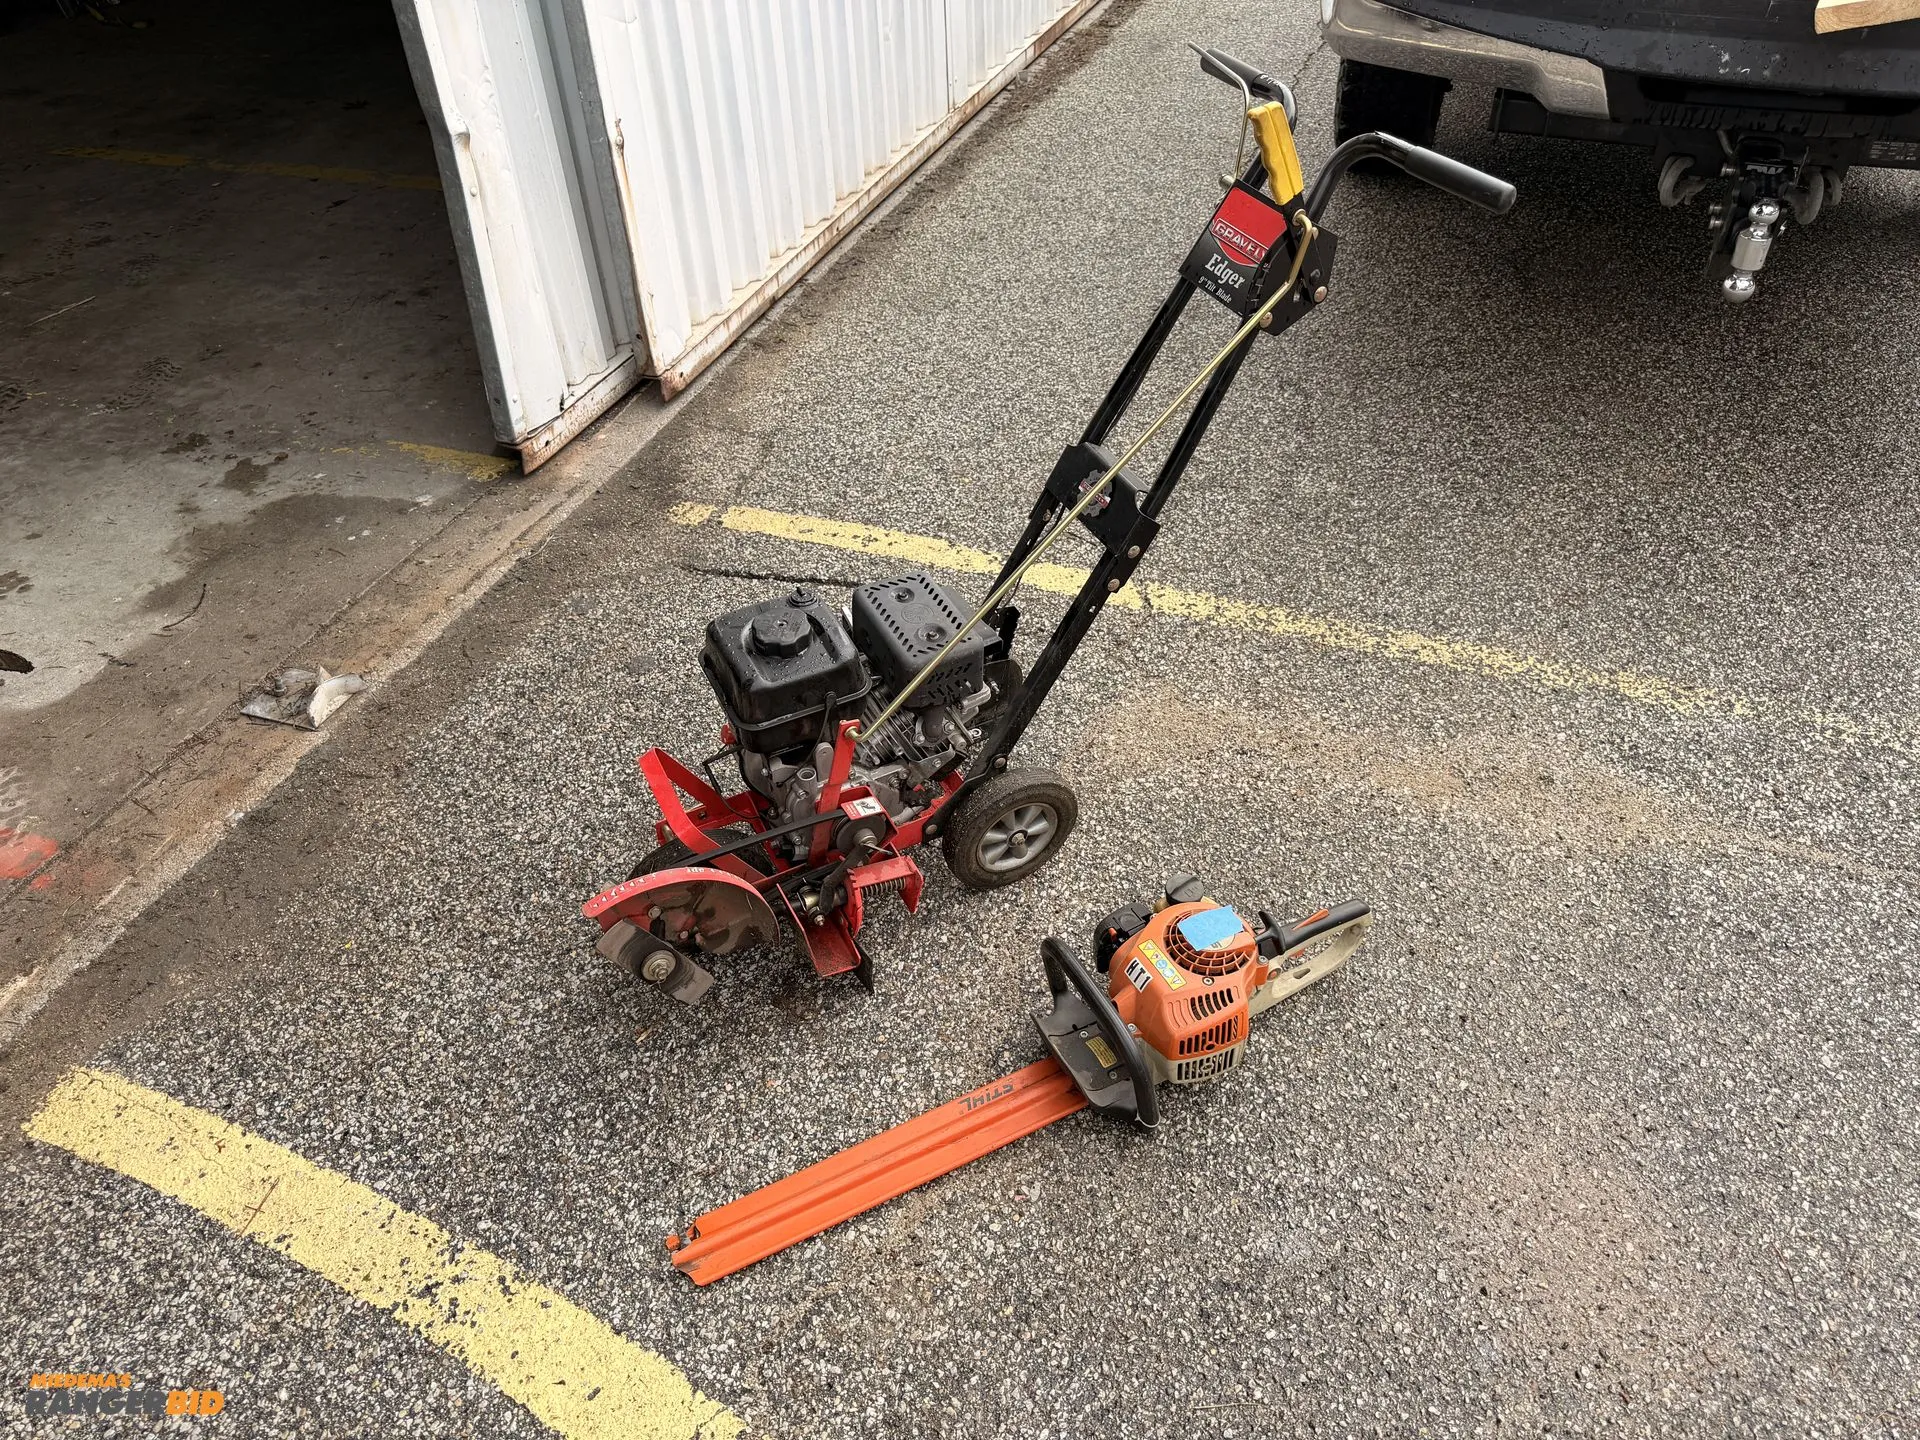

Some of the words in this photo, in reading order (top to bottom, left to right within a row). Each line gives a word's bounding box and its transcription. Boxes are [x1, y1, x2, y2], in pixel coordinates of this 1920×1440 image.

[1205, 253, 1245, 288] Edger
[1215, 288, 1232, 303] Blade
[1126, 958, 1151, 990] HT1
[958, 1083, 1014, 1111] STIHL
